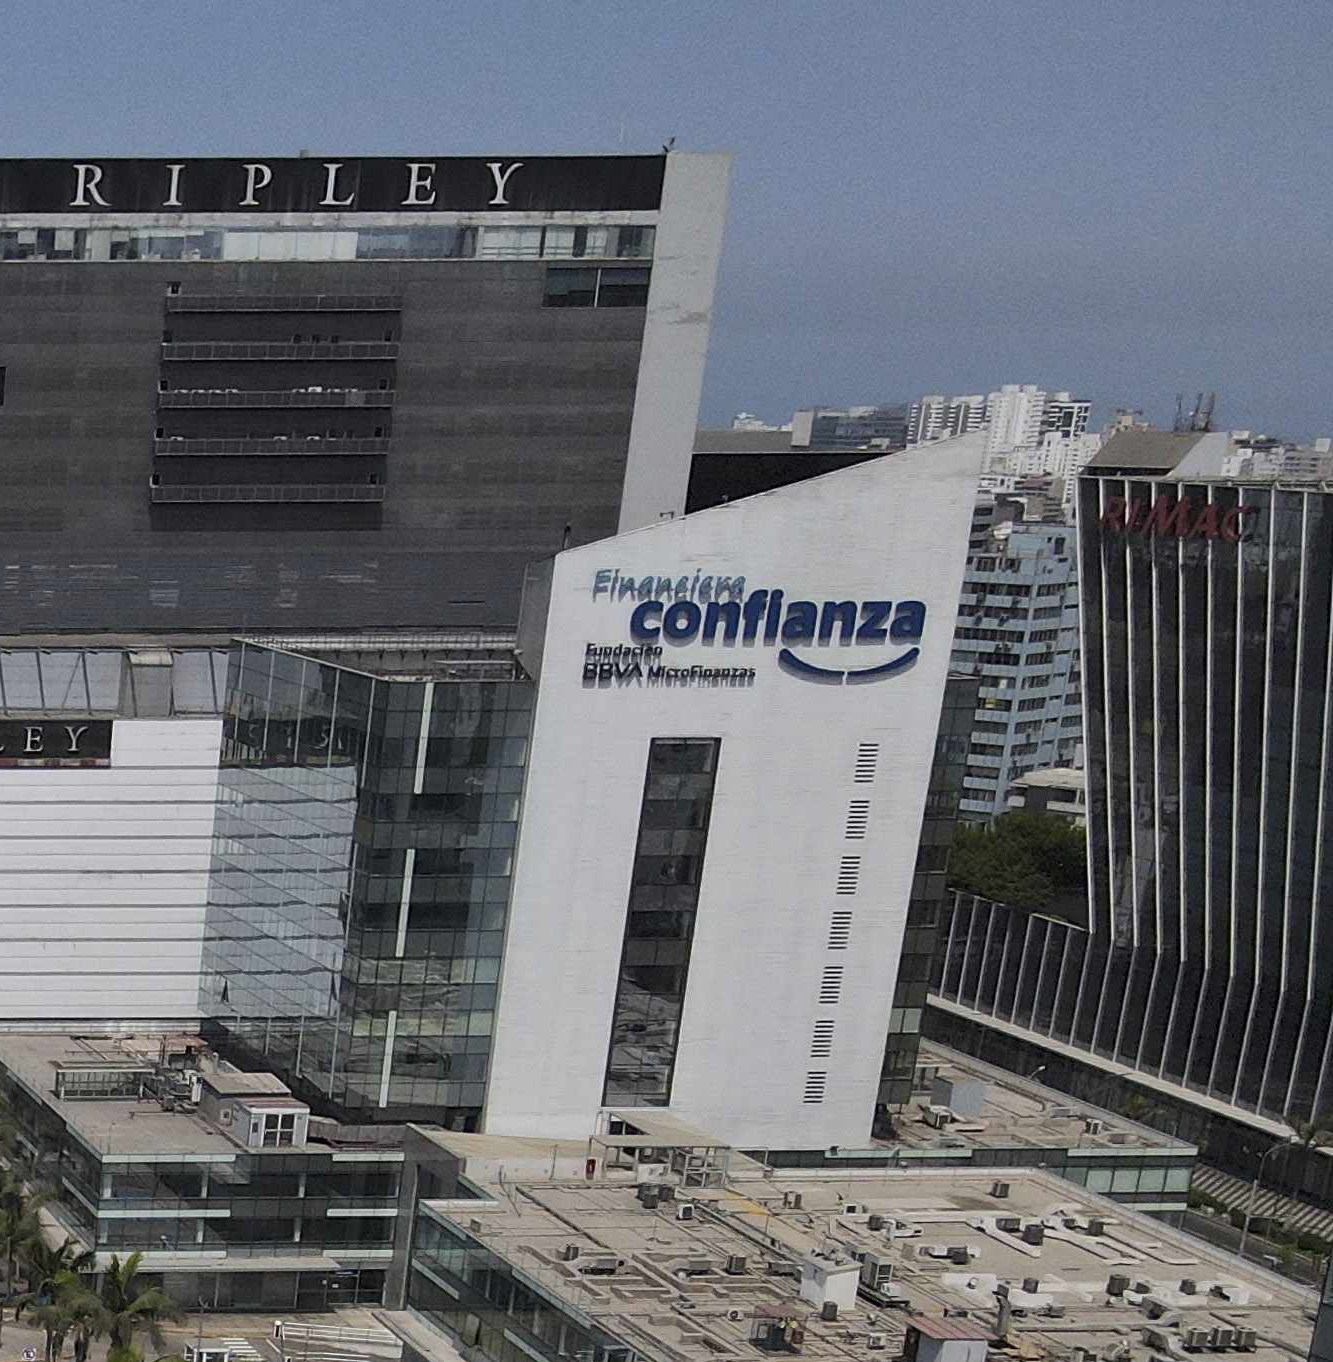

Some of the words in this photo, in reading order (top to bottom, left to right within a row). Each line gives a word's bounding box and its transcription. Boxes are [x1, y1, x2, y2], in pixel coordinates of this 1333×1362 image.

[70, 162, 523, 208] RIPLEY
[1099, 493, 1250, 542] RIMAC
[592, 567, 746, 603] Financiera
[629, 589, 927, 647] confianza
[582, 663, 644, 685] BBVA
